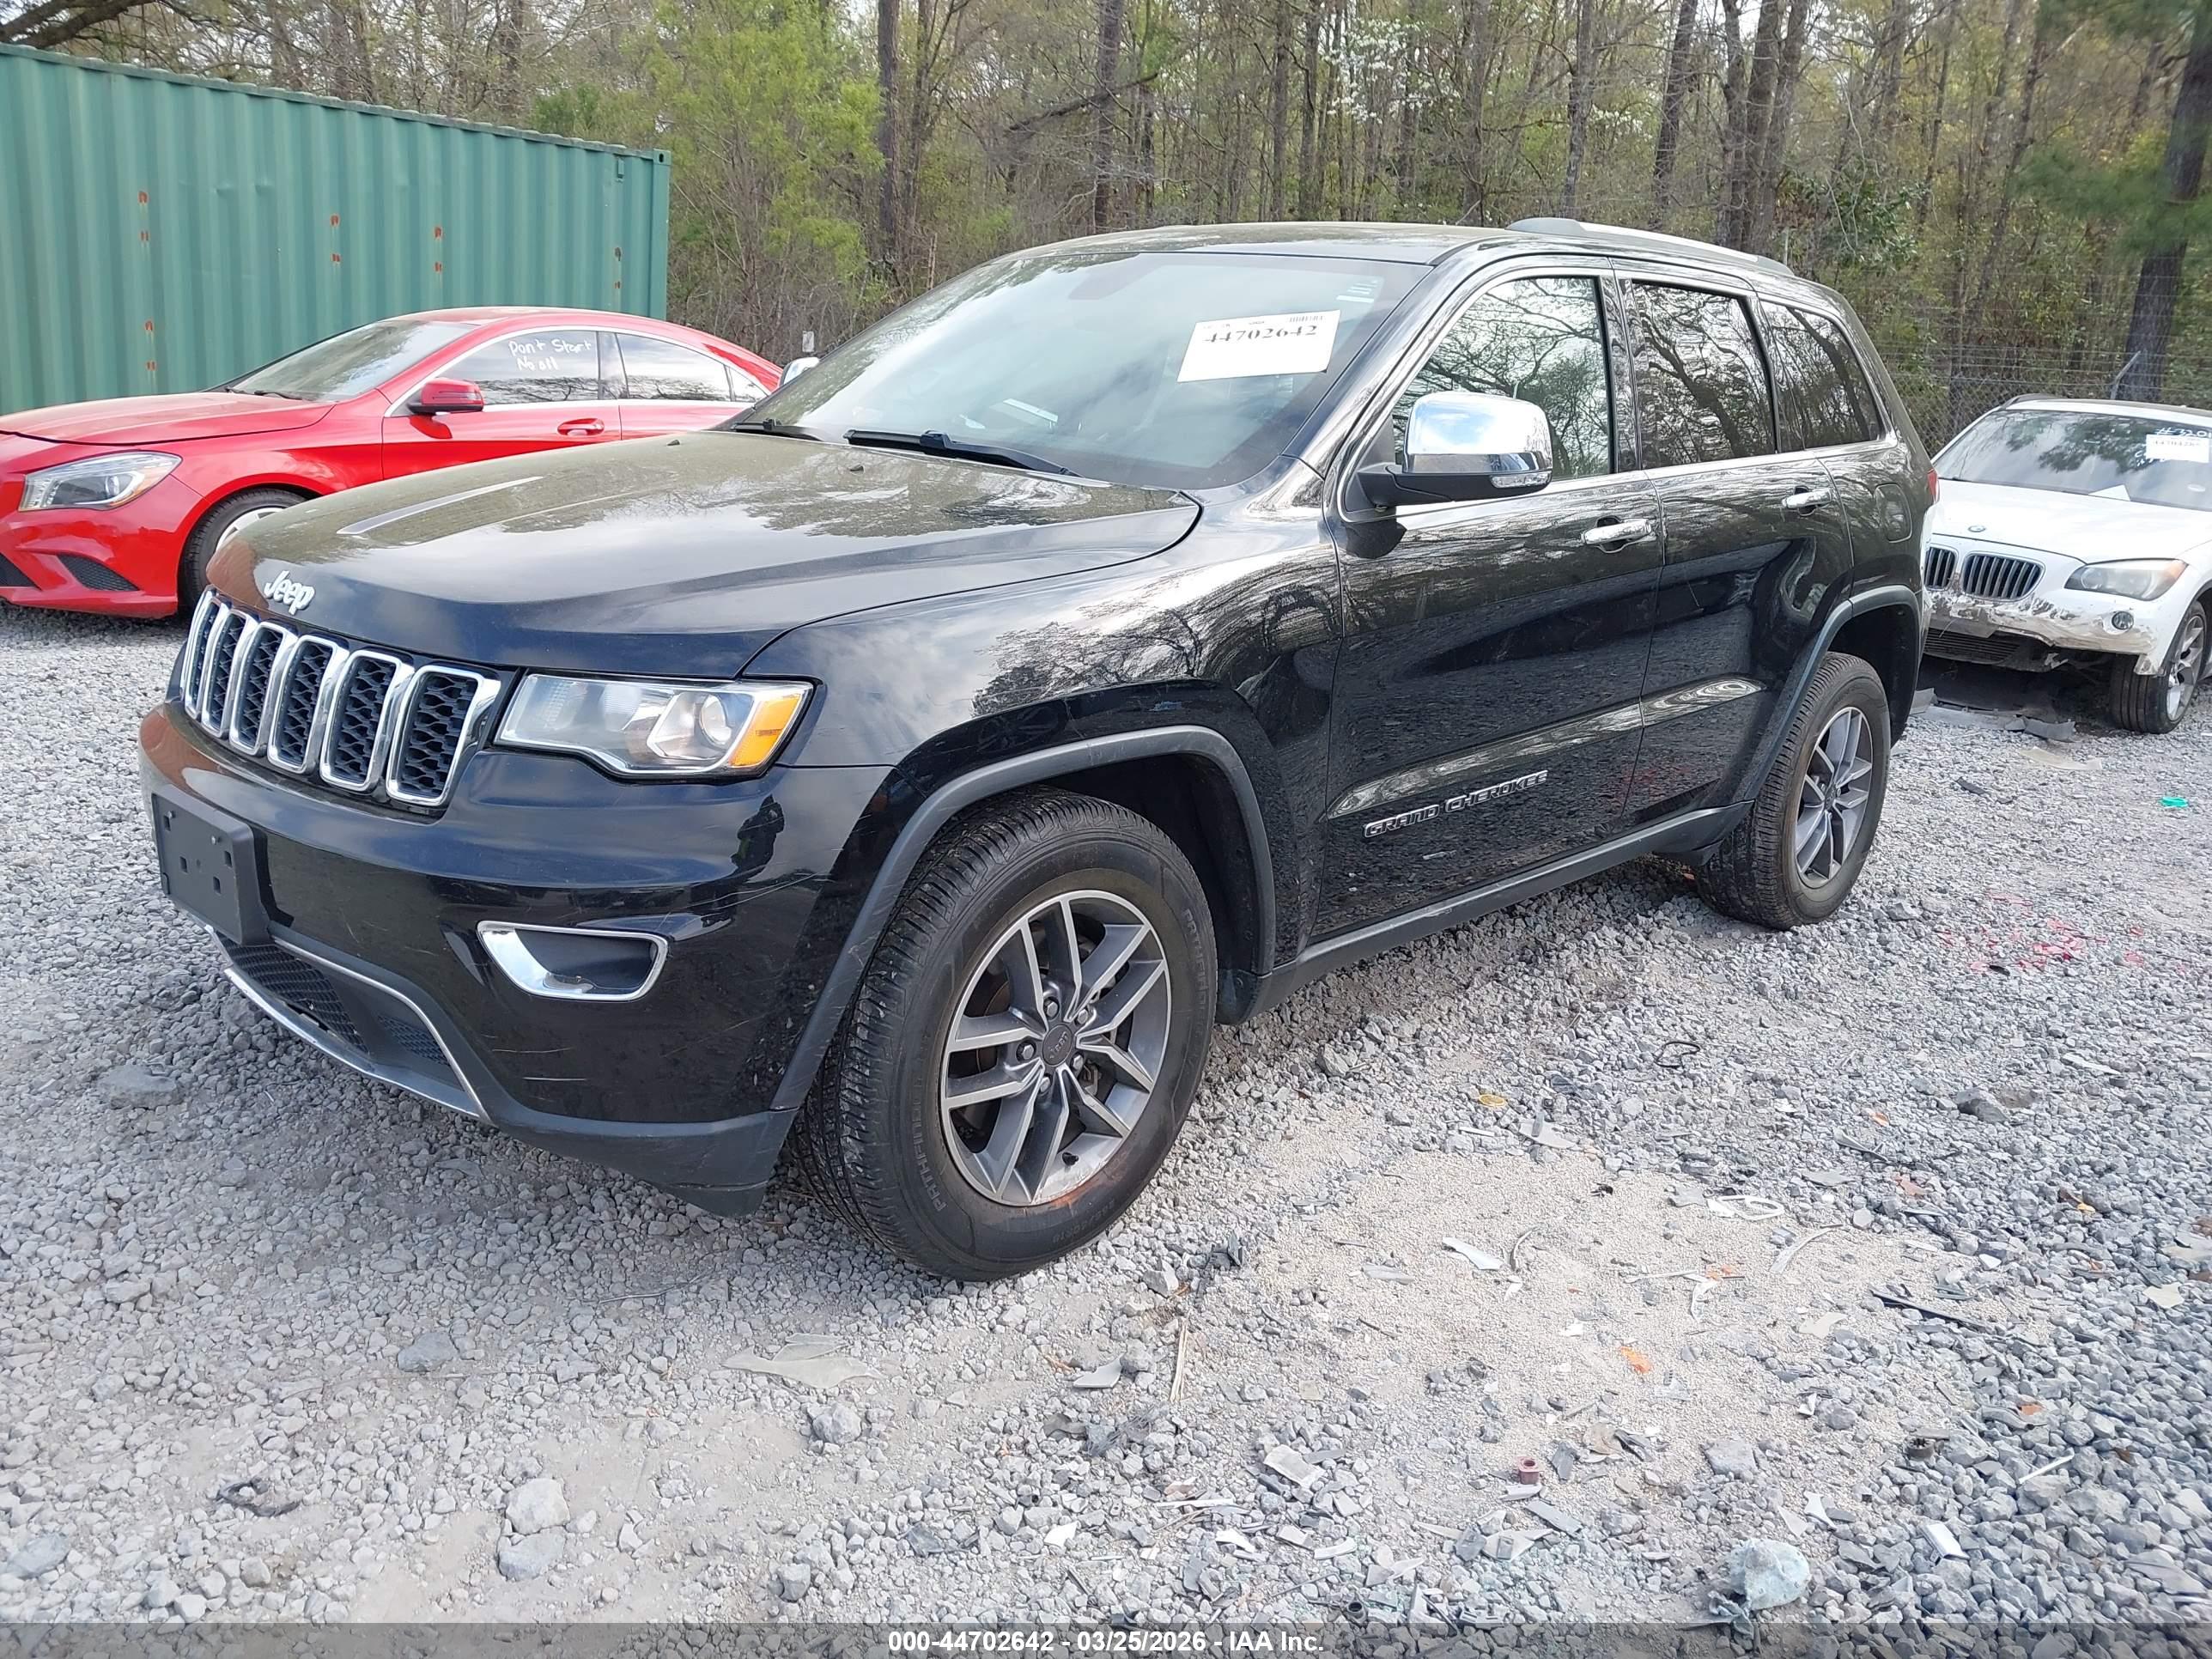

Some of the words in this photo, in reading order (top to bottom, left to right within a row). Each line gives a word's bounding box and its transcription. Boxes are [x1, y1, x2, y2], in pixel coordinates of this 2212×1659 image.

[1202, 325, 1318, 343] 44702642
[551, 338, 592, 354] Start
[517, 356, 536, 371] No
[264, 570, 315, 616] Jeep
[1364, 804, 1441, 838] GRAND
[1444, 769, 1549, 813] CHEROKEE
